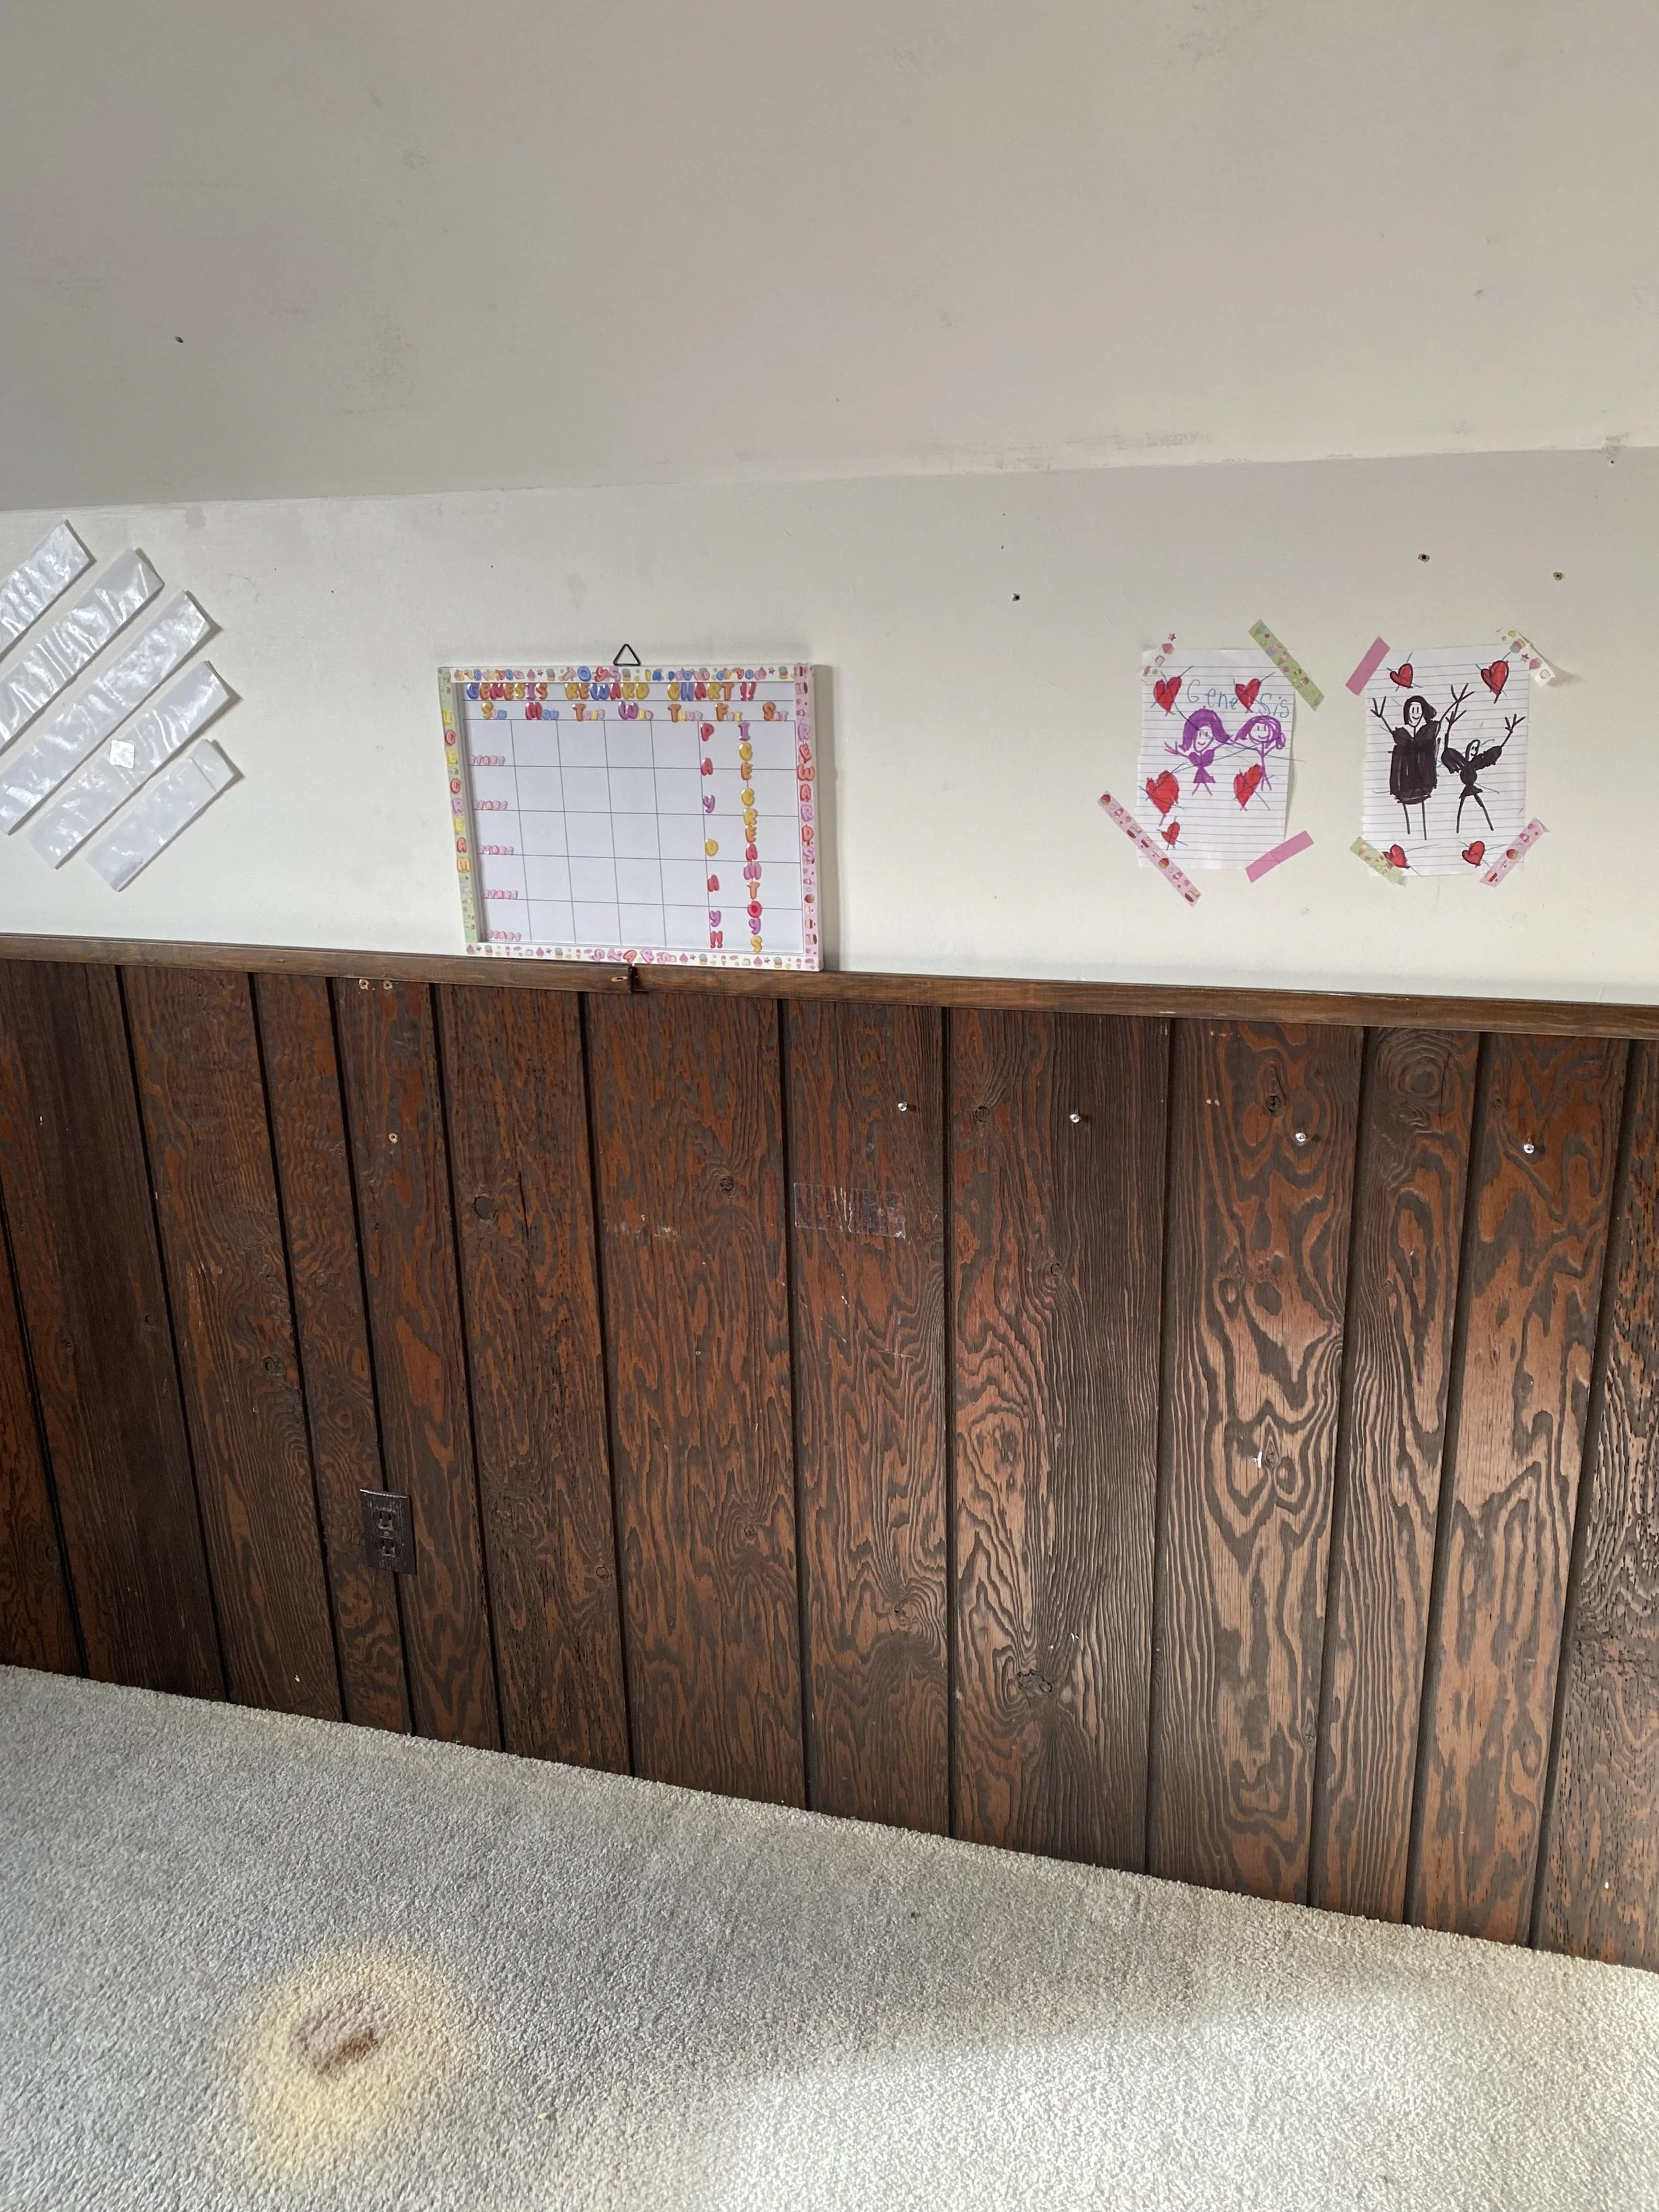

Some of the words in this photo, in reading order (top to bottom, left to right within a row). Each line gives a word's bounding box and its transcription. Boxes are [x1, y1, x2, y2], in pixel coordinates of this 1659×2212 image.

[467, 683, 548, 700] GENESIS
[565, 682, 650, 701] REWARD
[668, 682, 735, 701] CHART
